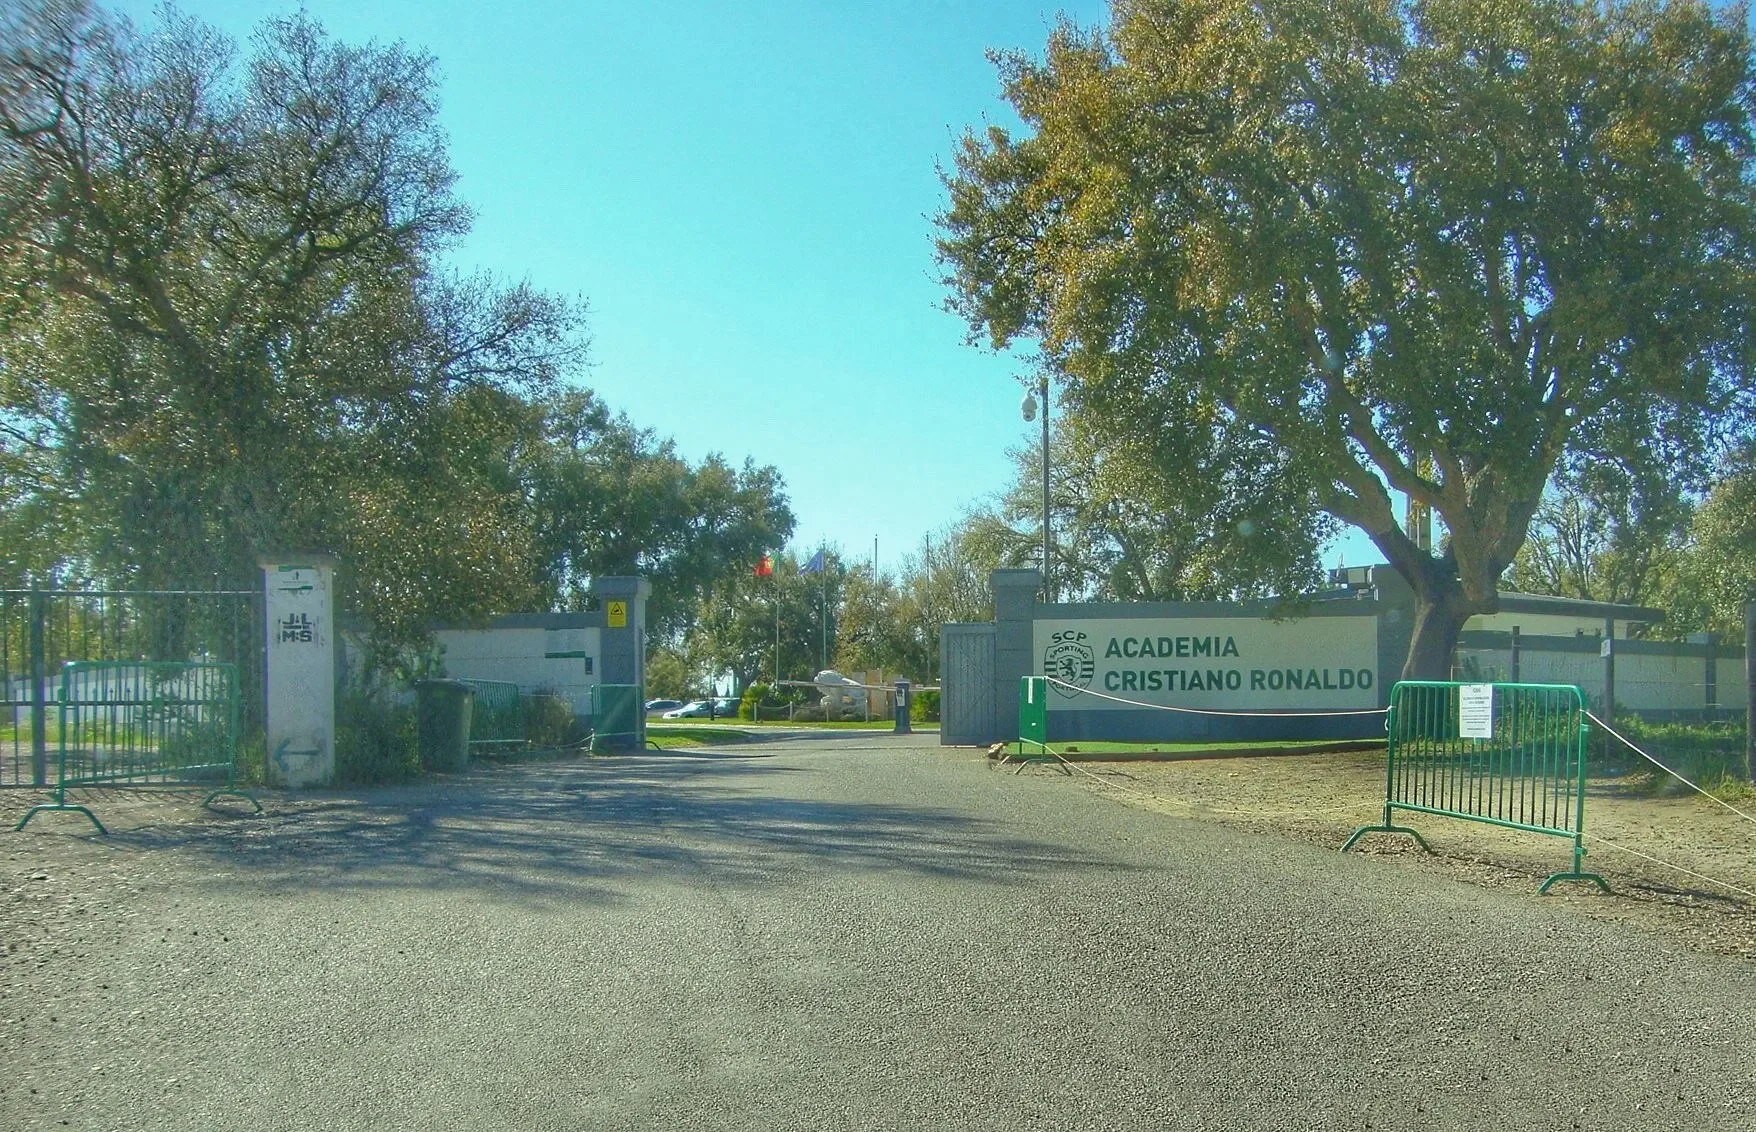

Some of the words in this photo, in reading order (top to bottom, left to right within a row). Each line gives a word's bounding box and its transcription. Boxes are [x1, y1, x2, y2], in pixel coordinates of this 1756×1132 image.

[1052, 630, 1087, 643] SCP
[1049, 646, 1089, 659] SPORTING
[1105, 636, 1240, 658] ACADEMIA
[1105, 669, 1243, 691] CRISTIANO
[1251, 669, 1374, 690] RONALDO
